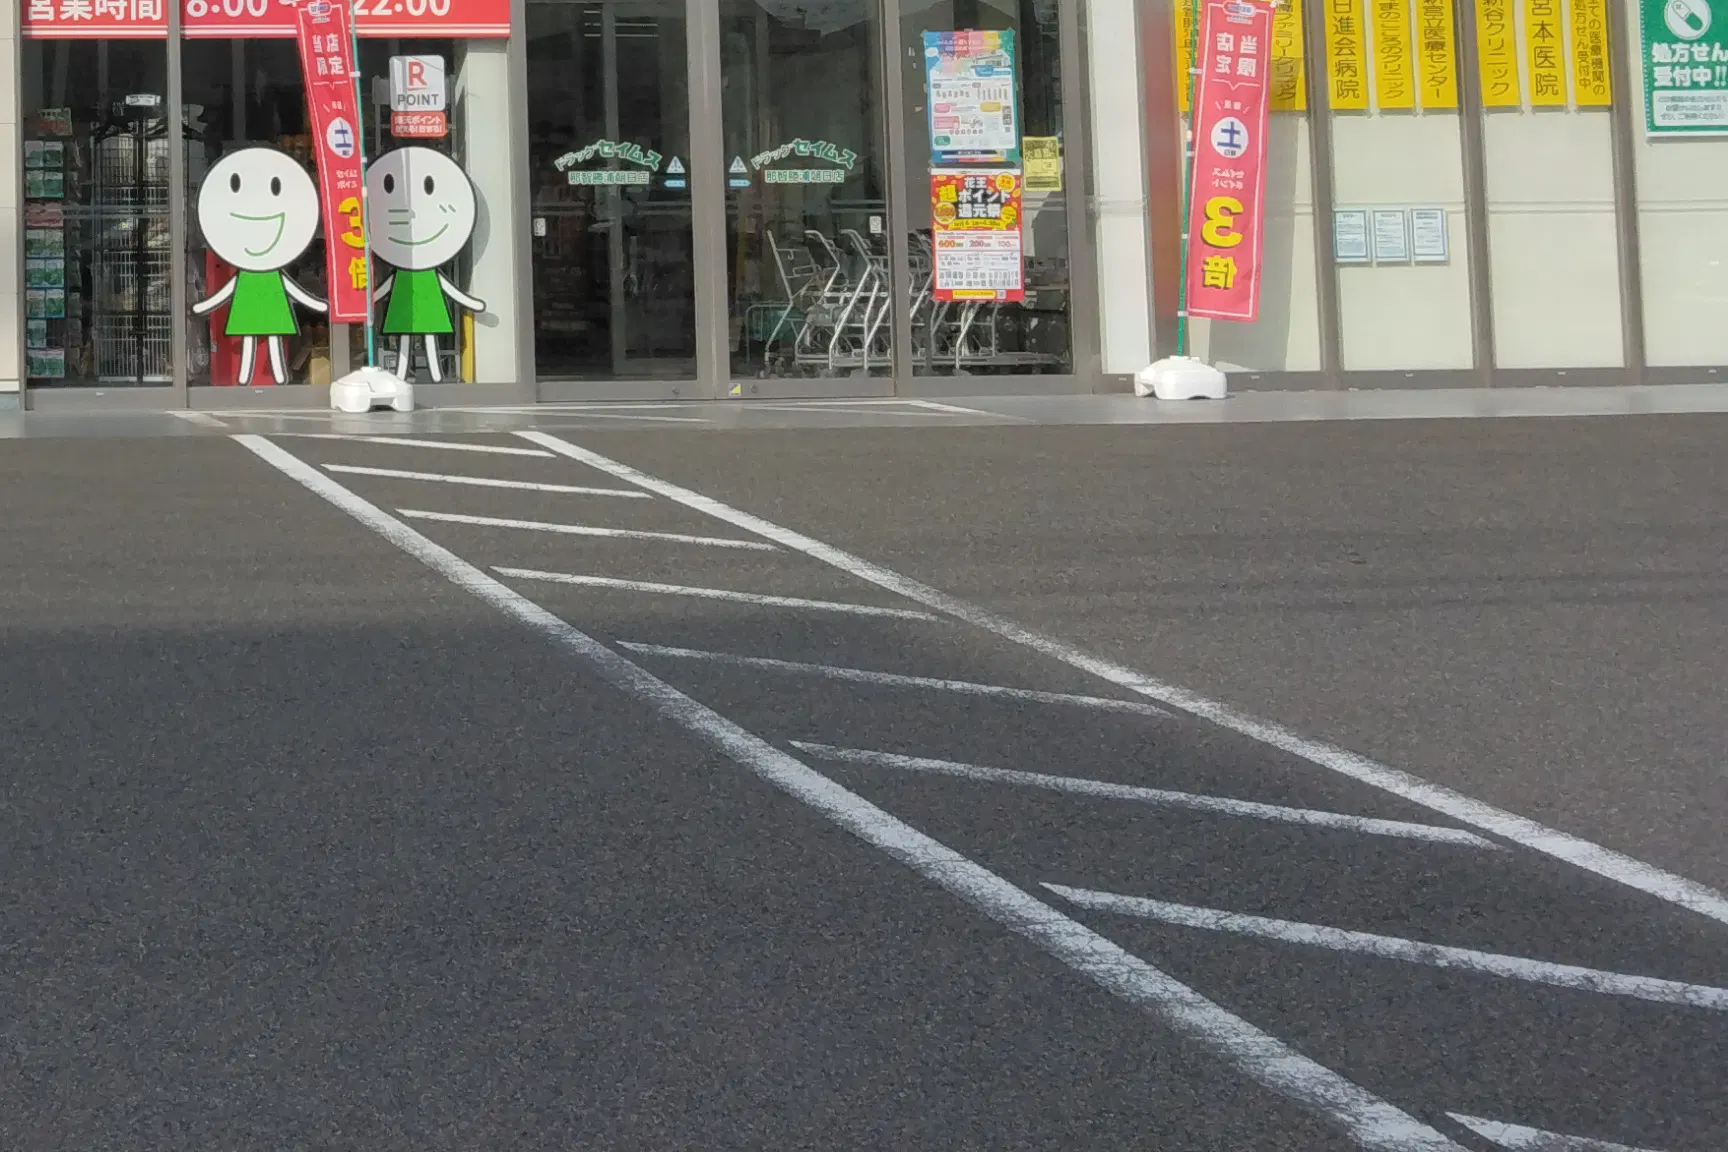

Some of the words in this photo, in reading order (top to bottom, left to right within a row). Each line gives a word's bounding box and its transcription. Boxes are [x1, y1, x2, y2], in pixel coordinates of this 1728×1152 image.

[1652, 41, 1728, 63] 処方せん
[408, 61, 427, 86] R
[397, 94, 439, 106] POINT
[554, 139, 662, 171] ドラッグセイムス
[751, 138, 857, 170] ドラッグセイムス
[958, 189, 1011, 203] ポイント
